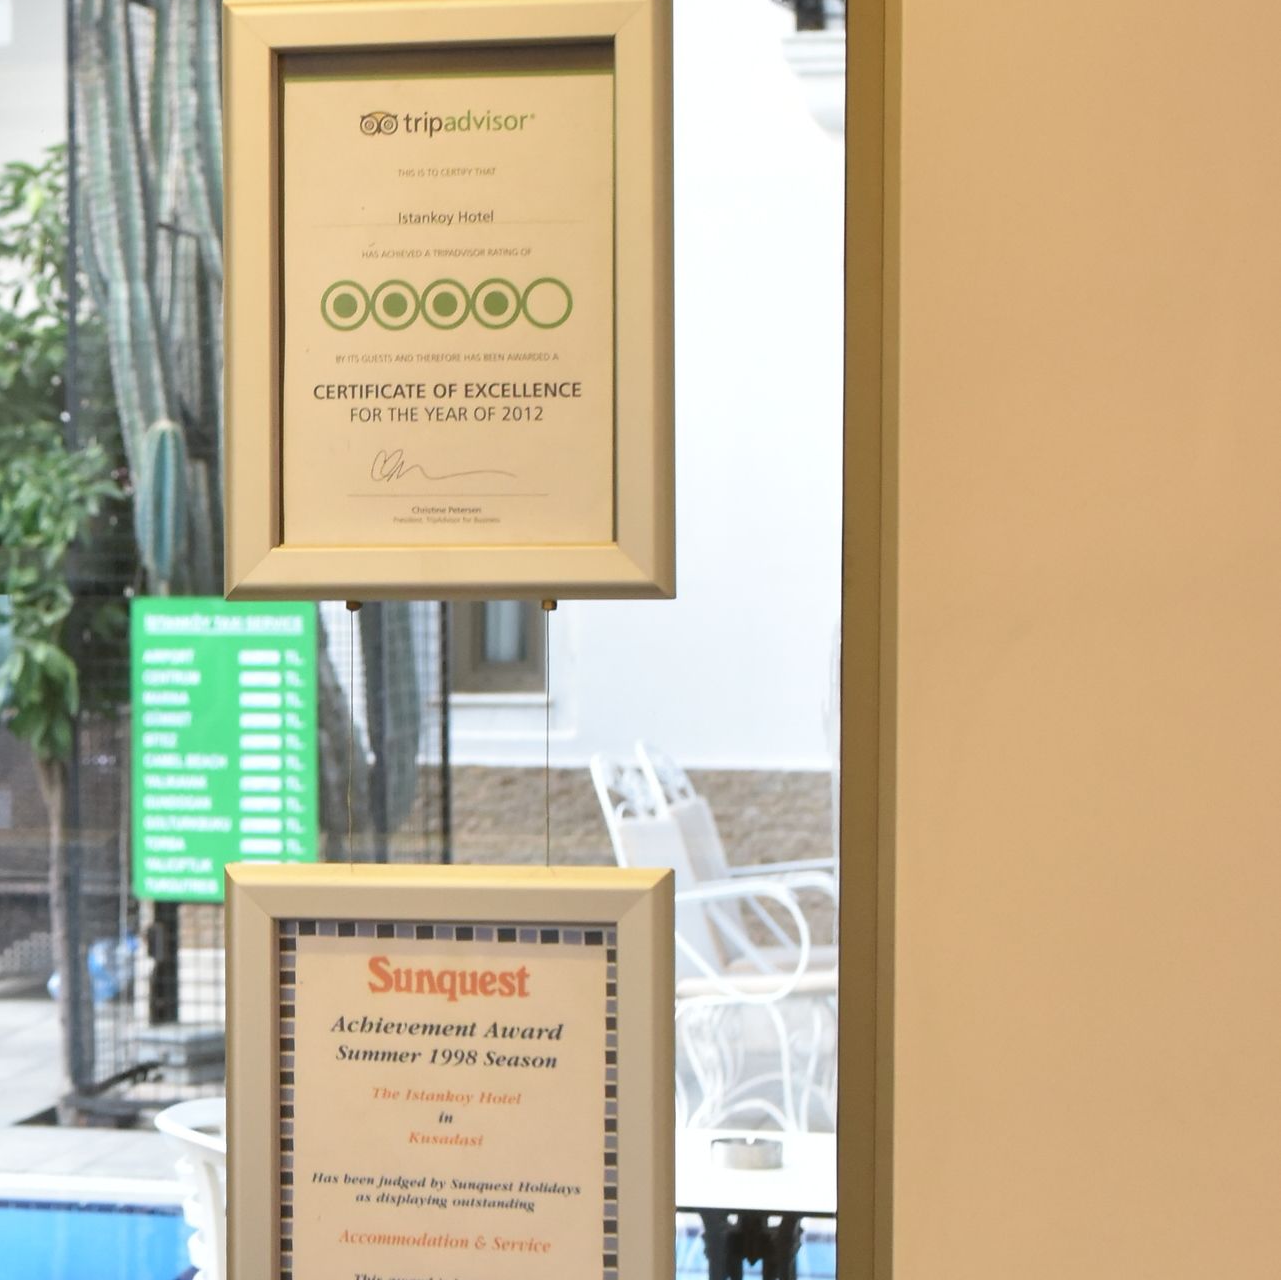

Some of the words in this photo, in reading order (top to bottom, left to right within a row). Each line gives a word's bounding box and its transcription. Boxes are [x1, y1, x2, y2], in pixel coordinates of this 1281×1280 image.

[398, 211, 453, 225] Istankoy
[458, 210, 494, 223] Hotel
[313, 384, 426, 400] CERTIFICATE
[433, 383, 458, 399] OF
[464, 382, 582, 398] EXCELLENCE
[350, 408, 382, 422] FOR
[389, 408, 418, 421] THE
[424, 407, 468, 421] YEAR
[474, 406, 496, 421] OF
[502, 406, 543, 421] 2012
[368, 956, 530, 1002] Sunquest
[331, 1016, 476, 1038] Achievement
[484, 1022, 563, 1040] Award
[336, 1045, 421, 1063] Summer
[429, 1049, 477, 1065] 1998
[484, 1050, 557, 1069] Season
[372, 1086, 400, 1100] The
[405, 1088, 473, 1105] Istankoy
[479, 1091, 522, 1105] Hotel
[439, 1111, 453, 1124] in
[408, 1132, 484, 1147] Kusadasi
[312, 1172, 338, 1184] Has
[344, 1174, 374, 1187] been
[377, 1176, 426, 1189] judged
[430, 1177, 446, 1190] by
[451, 1178, 514, 1194] Sunquest
[519, 1181, 581, 1195] Holidays
[356, 1193, 371, 1203] as
[376, 1193, 447, 1209] displaying
[452, 1197, 535, 1212] outstanding
[339, 1229, 468, 1249] Accommodation
[474, 1236, 486, 1250] &
[492, 1236, 551, 1254] Service
